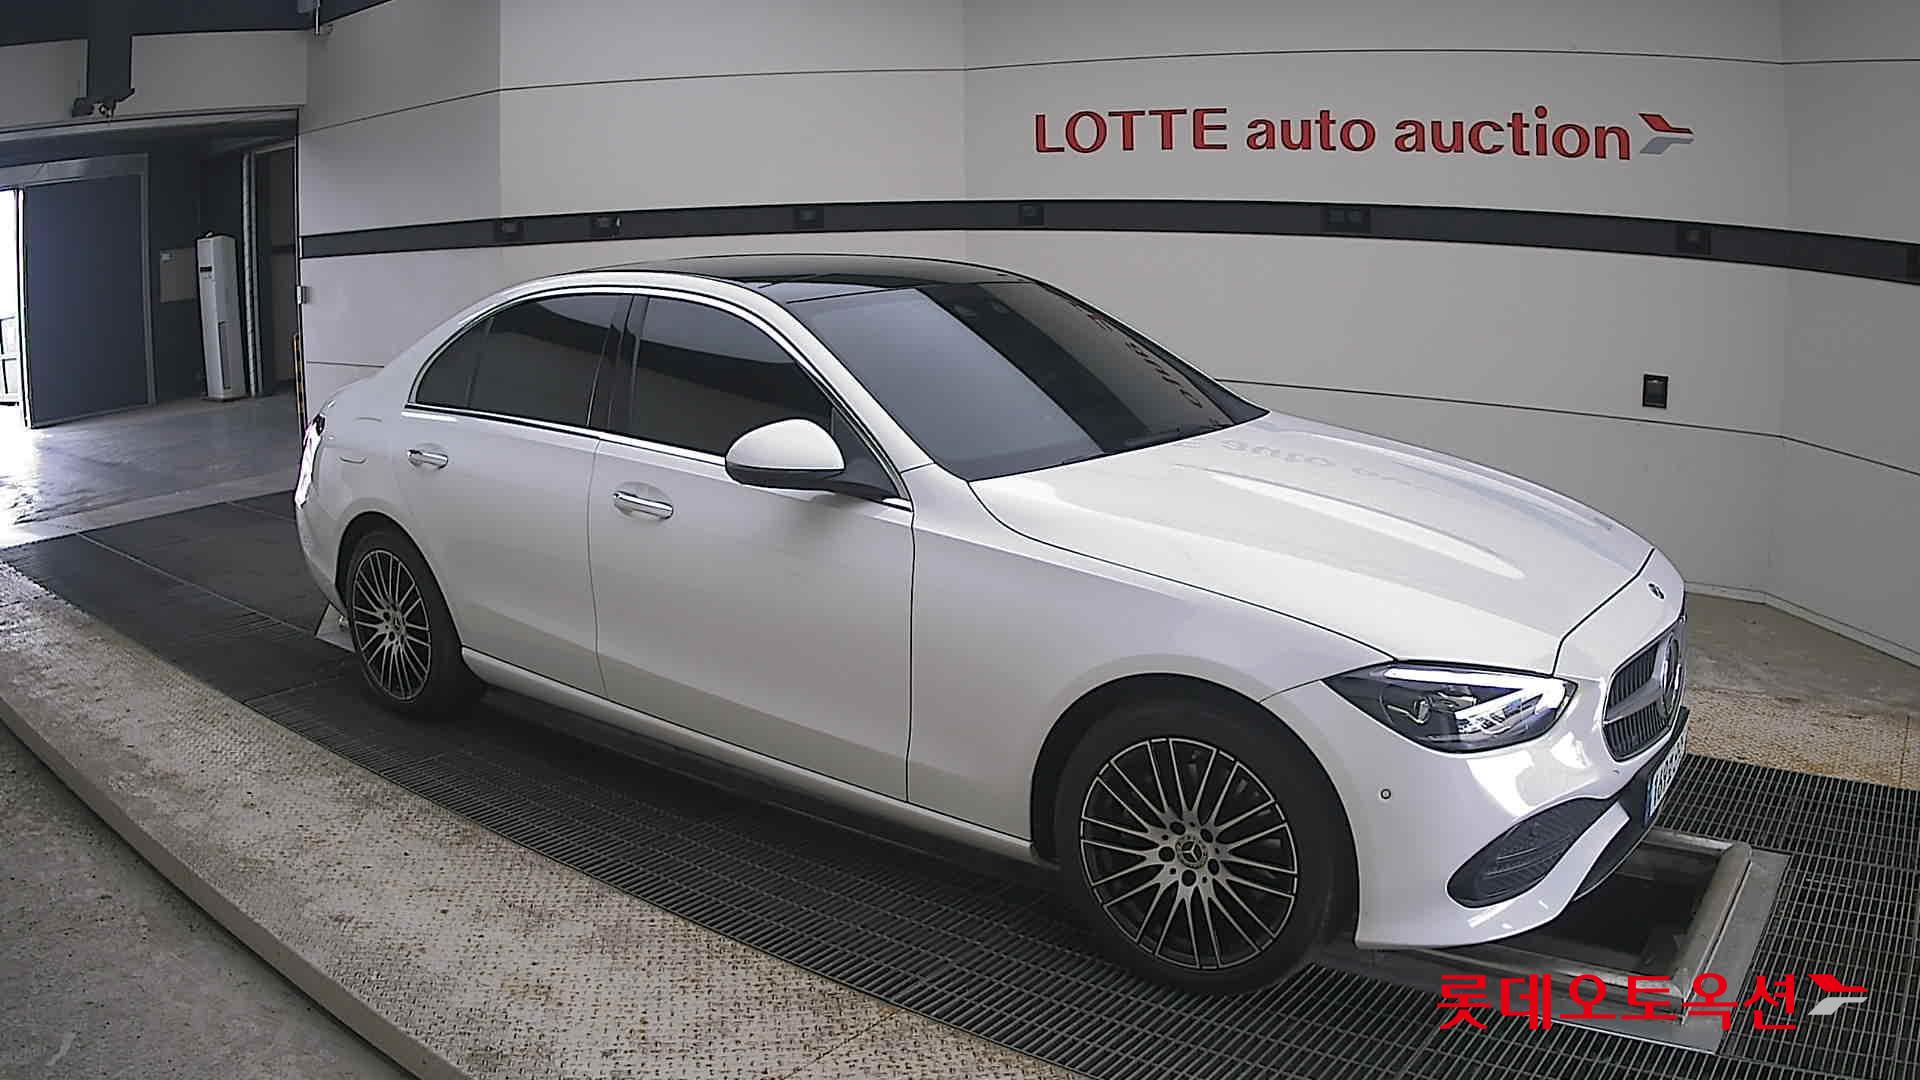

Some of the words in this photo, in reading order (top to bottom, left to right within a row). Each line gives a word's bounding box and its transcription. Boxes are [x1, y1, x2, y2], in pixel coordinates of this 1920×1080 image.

[1035, 108, 1228, 153] LOTTE
[1247, 110, 1376, 152] auto
[1394, 105, 1631, 161] auction
